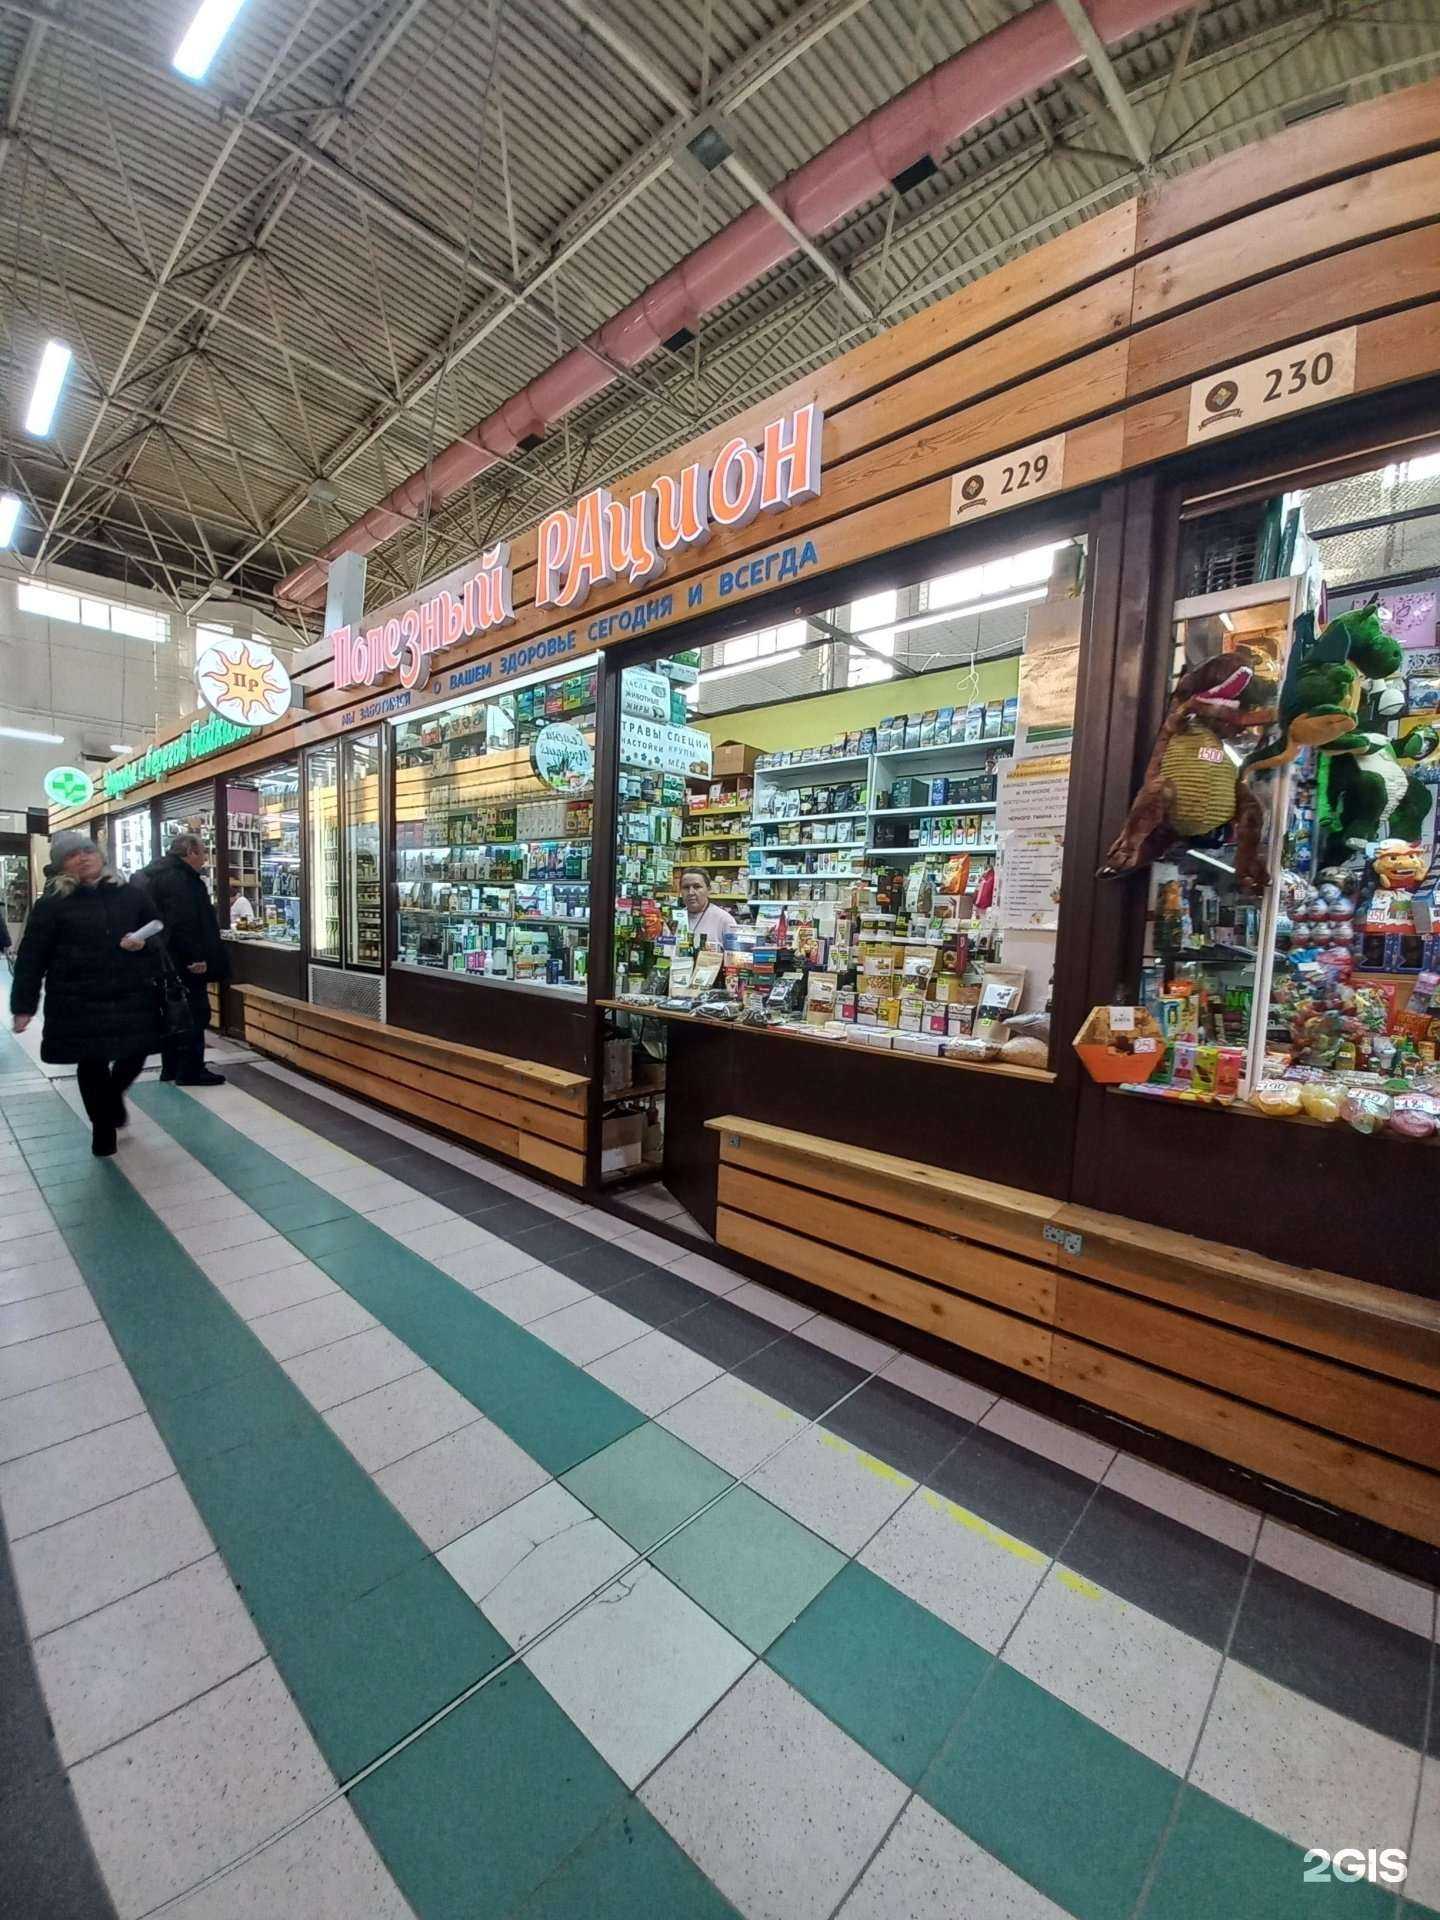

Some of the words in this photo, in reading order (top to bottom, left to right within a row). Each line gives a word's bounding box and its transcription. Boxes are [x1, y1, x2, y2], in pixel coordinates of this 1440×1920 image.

[1263, 351, 1334, 403] 230
[1000, 454, 1049, 495] 229
[432, 682, 442, 695] О
[449, 662, 493, 690] ВАШЕМ
[500, 629, 577, 674] ЗДОРОВЬЕ
[588, 593, 674, 642] СЕГОДНЯ
[688, 582, 704, 608] И
[719, 540, 819, 597] ВСЕГДА
[625, 702, 650, 714] ЖИРЫ
[621, 720, 661, 740] ТРАВЫ
[667, 731, 709, 750] СПЕЦИИ
